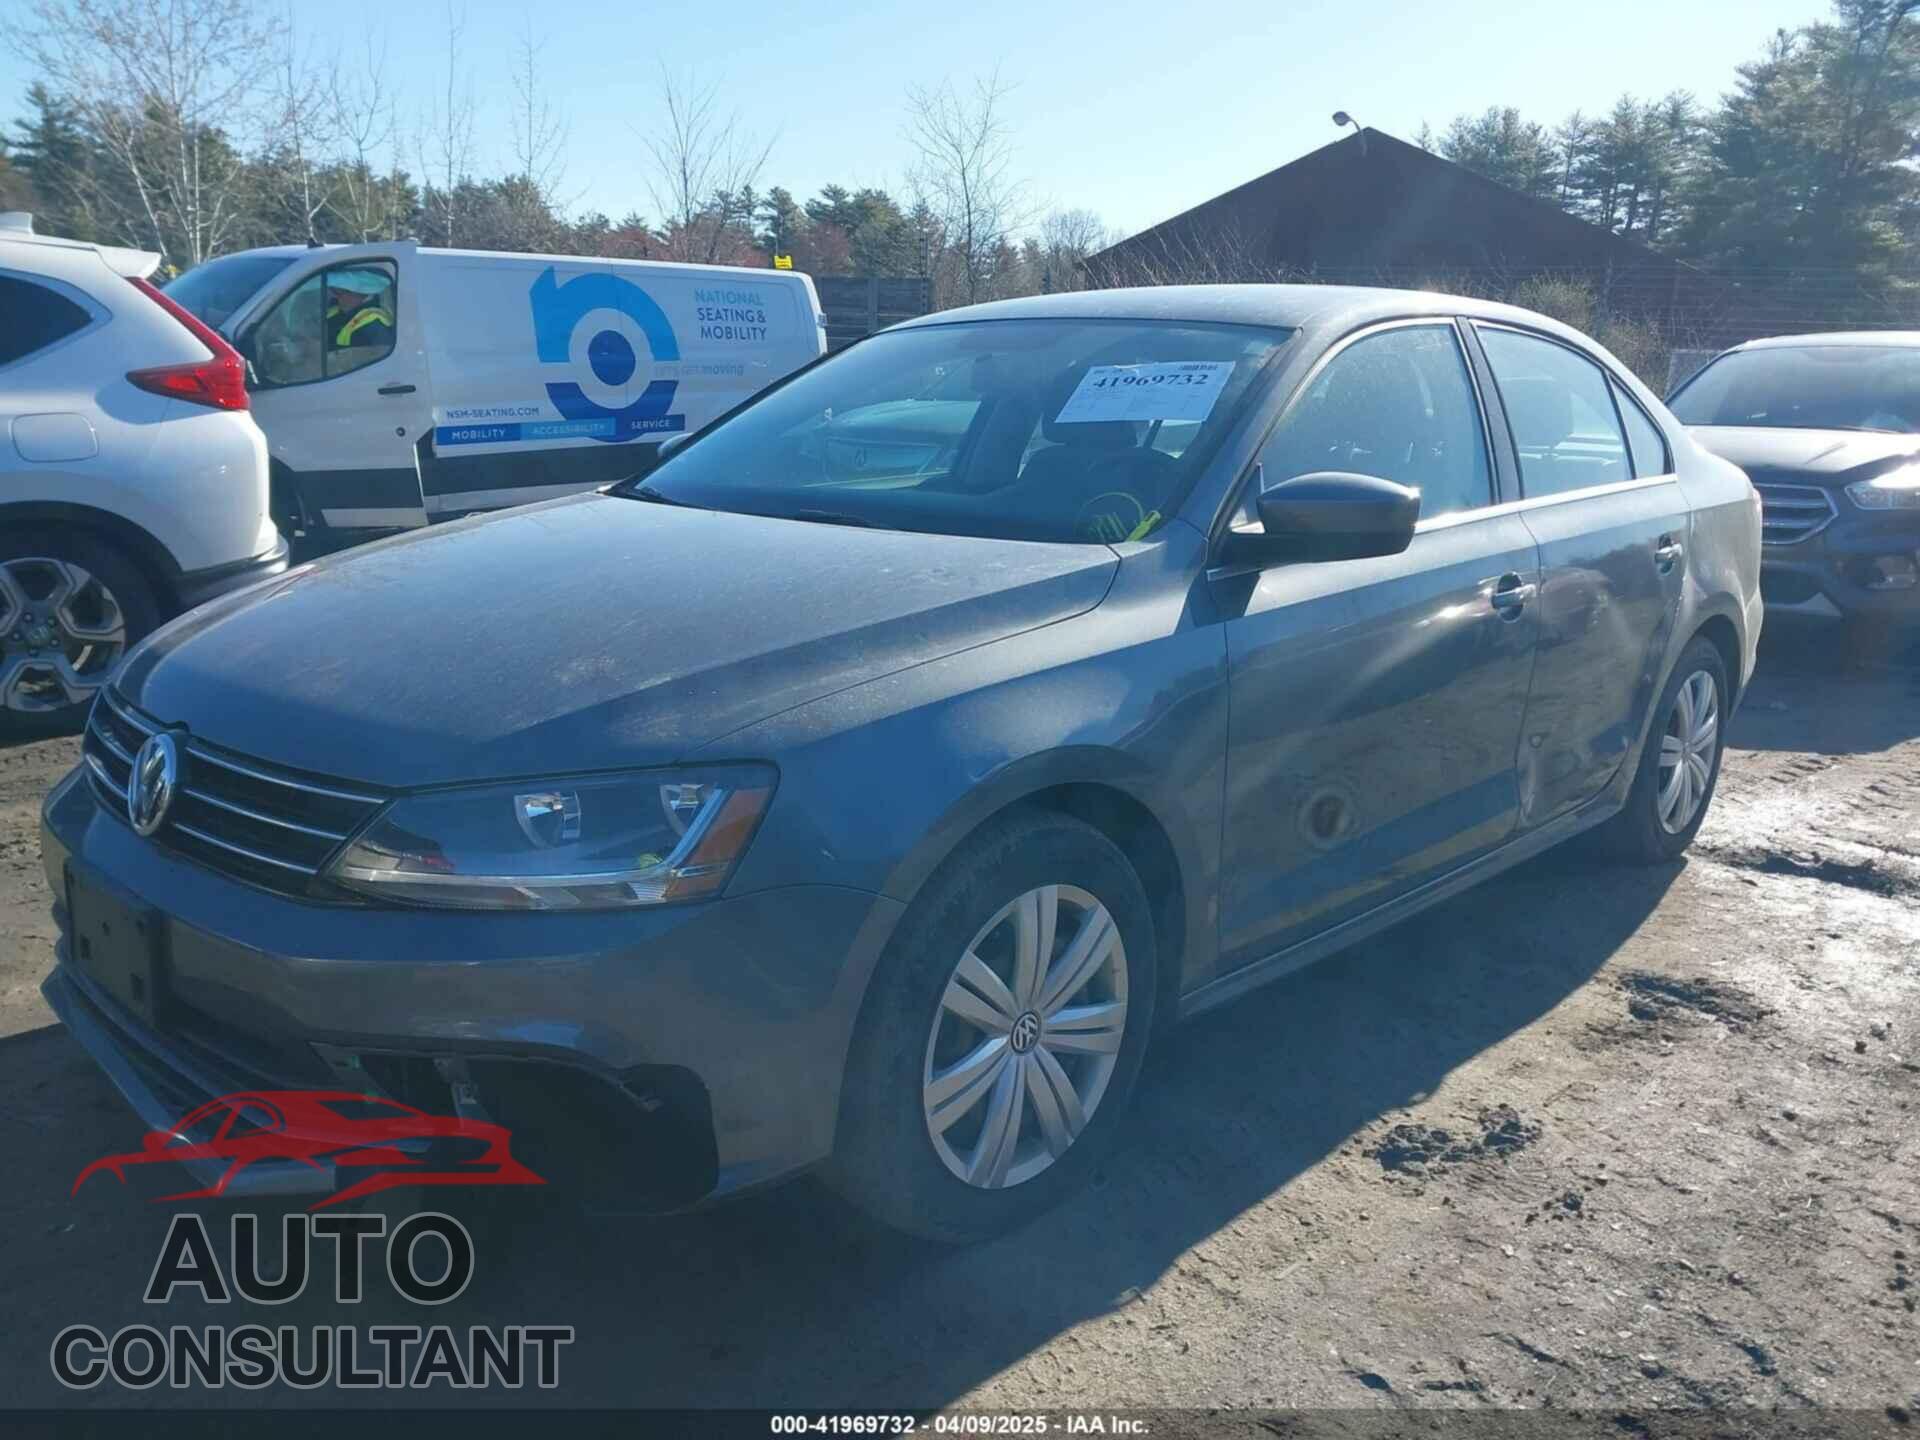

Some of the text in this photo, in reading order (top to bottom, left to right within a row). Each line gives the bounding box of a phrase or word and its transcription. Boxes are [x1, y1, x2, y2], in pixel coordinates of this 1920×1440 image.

[695, 288, 765, 306] NATIONAL
[697, 307, 755, 323] SEATING
[701, 326, 767, 341] MOBILITY
[1093, 373, 1209, 388] 41969732
[447, 407, 540, 419] NSM-SEATING.COM
[452, 427, 507, 441] MOBILITY
[631, 418, 671, 431] SERVICE
